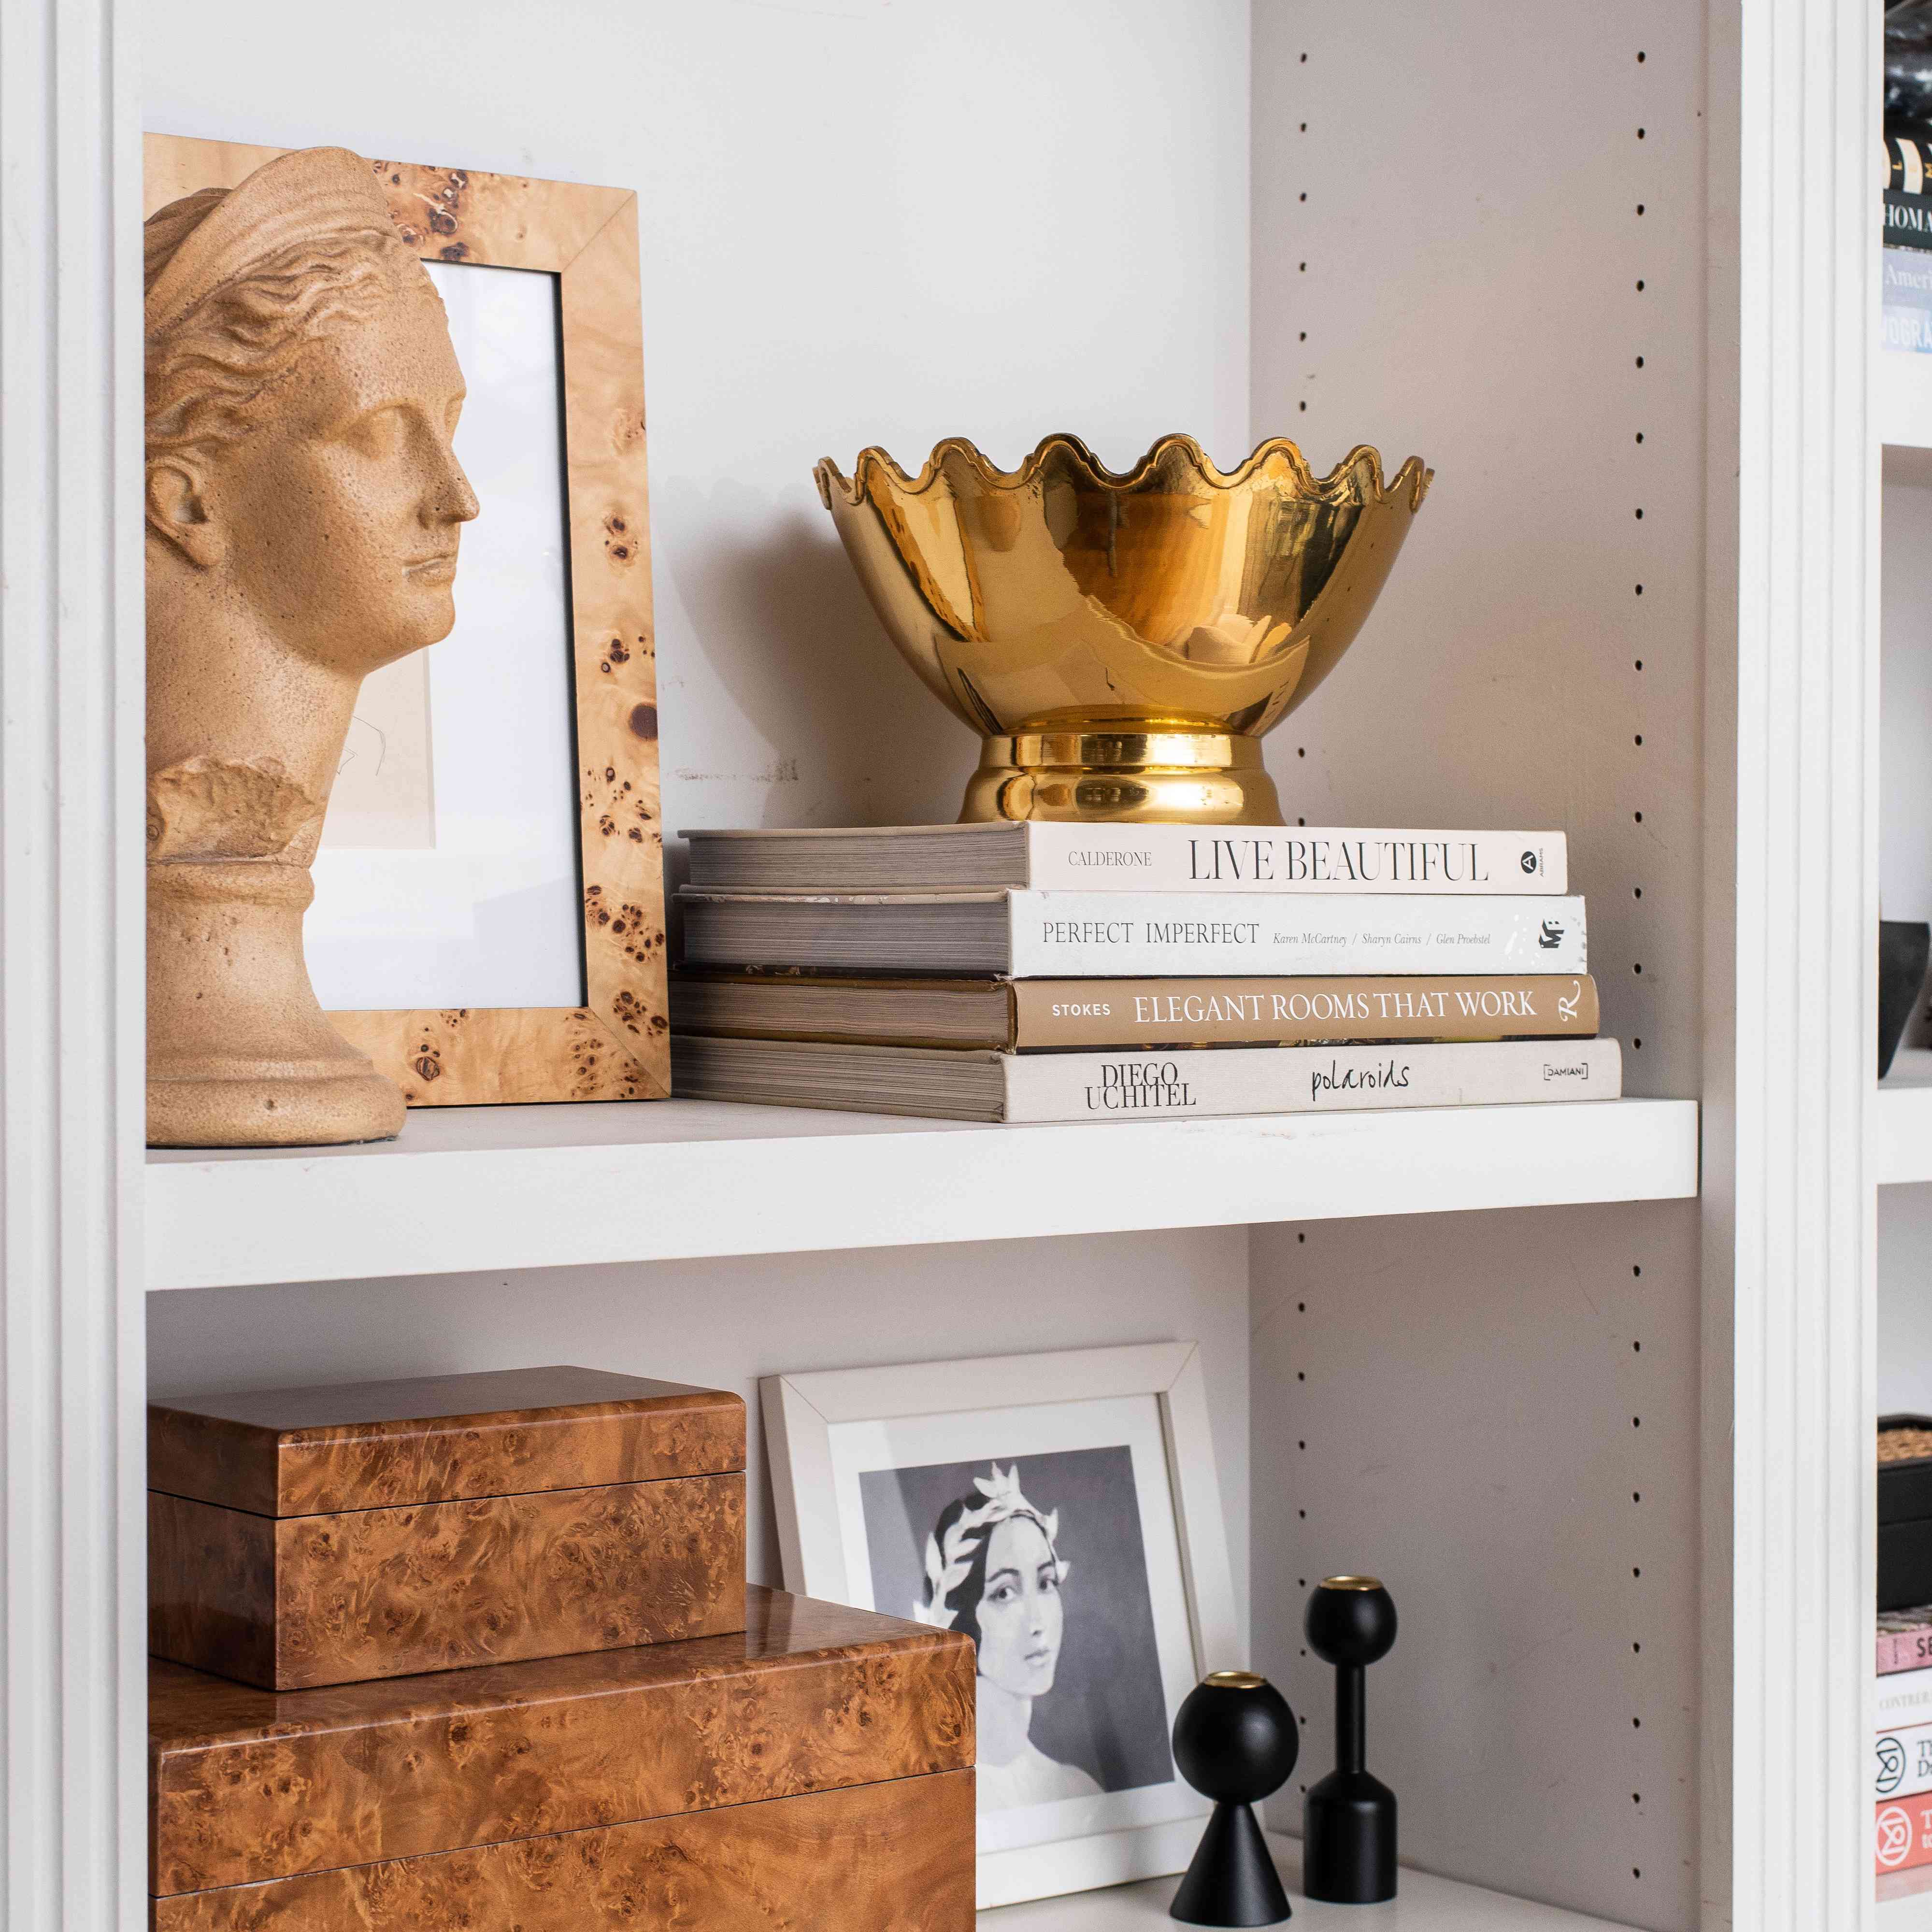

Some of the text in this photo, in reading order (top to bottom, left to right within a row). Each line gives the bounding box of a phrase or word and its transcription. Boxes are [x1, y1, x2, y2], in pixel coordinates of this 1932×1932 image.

[1068, 851, 1152, 866] CALDERONE
[1188, 840, 1488, 881] LIVE BEAUTIFUL
[1043, 922, 1259, 944] PERFECT IMPERFECT
[1273, 933, 1299, 944] Karen
[1301, 933, 1347, 947] McCartney
[1361, 933, 1391, 947] Sharyn
[1394, 933, 1422, 944] Cairns
[1436, 933, 1455, 944] Glen
[1457, 933, 1491, 944] Proebstel
[1052, 1003, 1111, 1016] STOKES
[1132, 991, 1538, 1023] ELEGANT ROOMS THAT WORK
[1101, 1062, 1178, 1088] DIEGO
[1312, 1059, 1410, 1102] polaroids
[1084, 1083, 1197, 1110] UCHITEL
